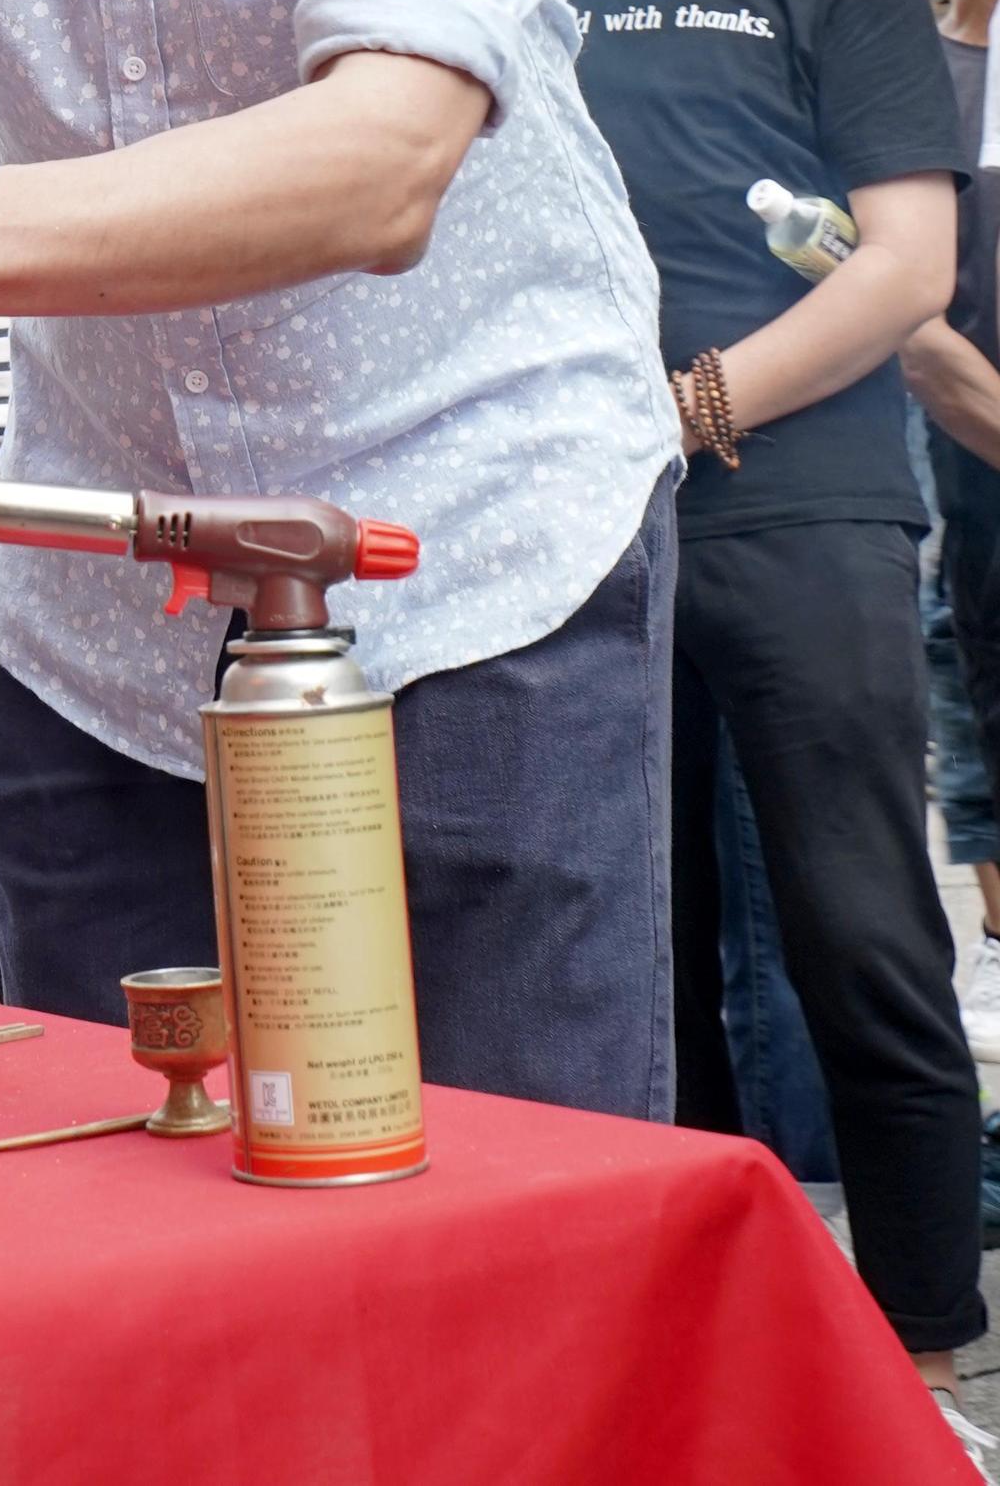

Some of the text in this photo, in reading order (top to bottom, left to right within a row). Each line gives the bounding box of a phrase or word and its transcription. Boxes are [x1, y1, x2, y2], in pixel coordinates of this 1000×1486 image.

[604, 4, 663, 32] with
[675, 3, 776, 39] thanks.
[236, 856, 273, 867] Caution
[342, 1096, 383, 1108] COMPANY
